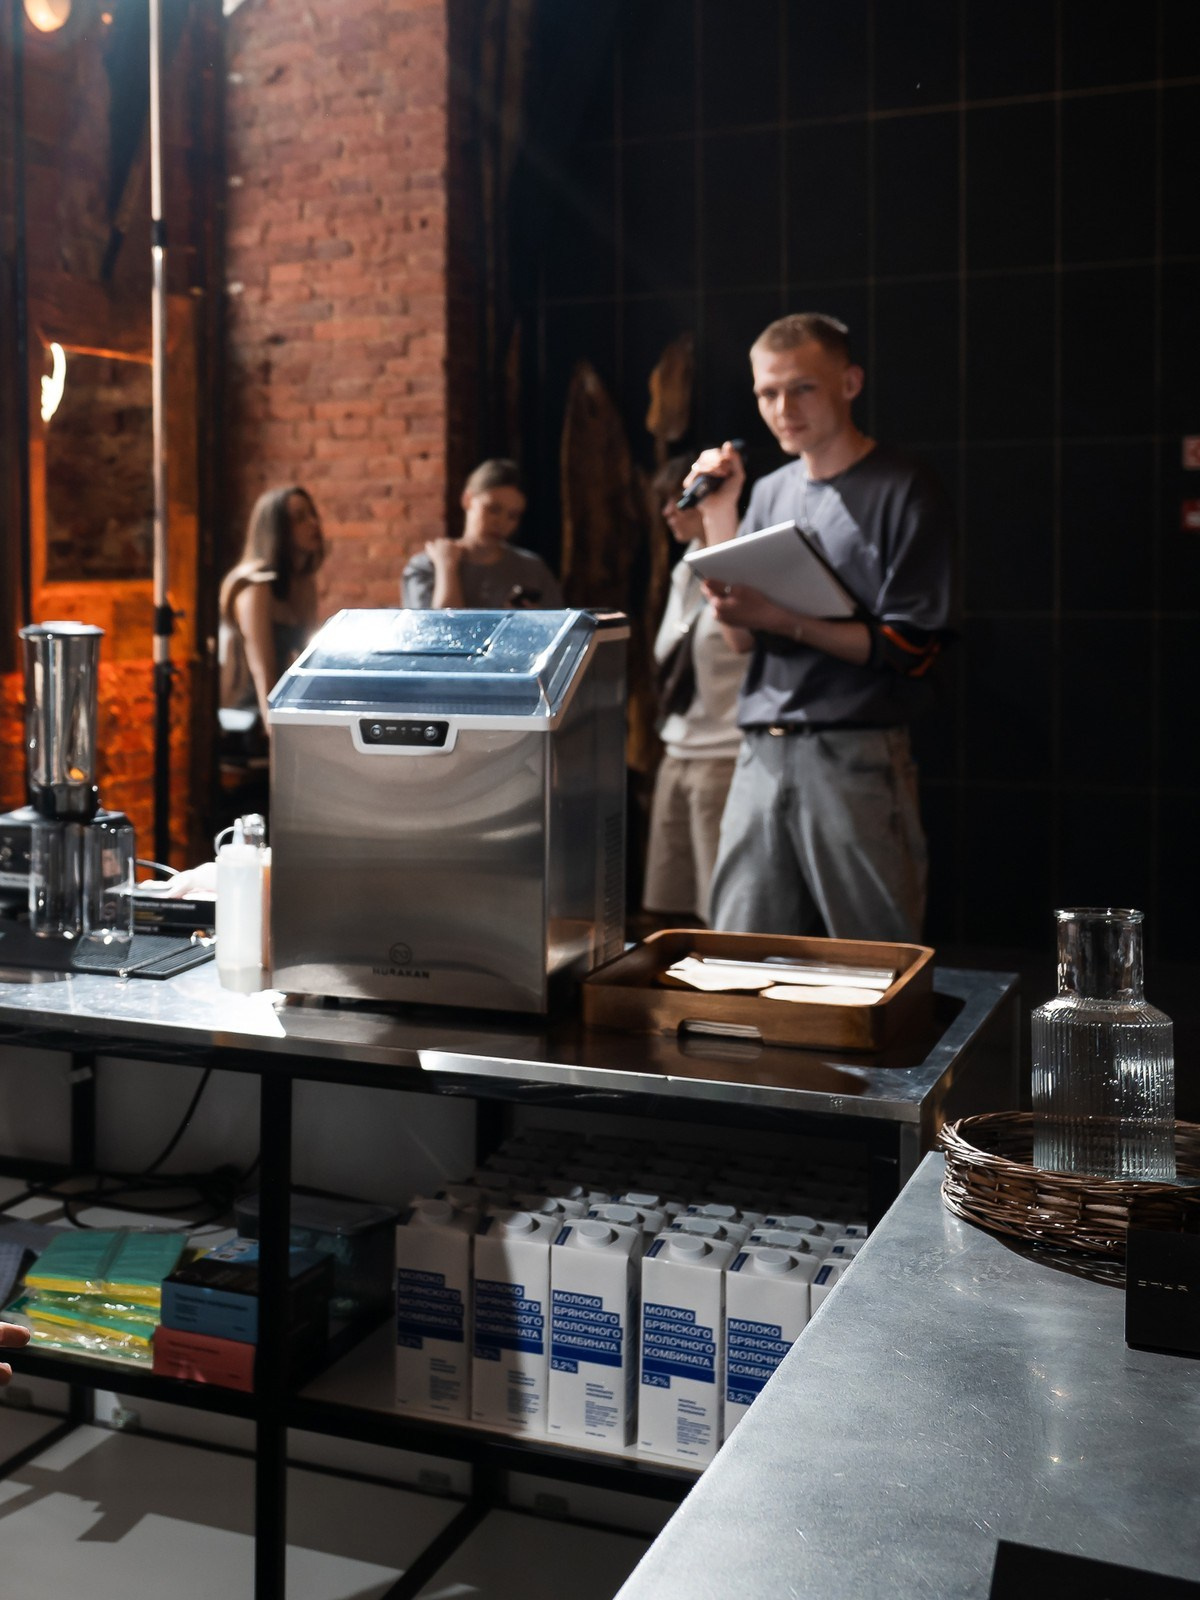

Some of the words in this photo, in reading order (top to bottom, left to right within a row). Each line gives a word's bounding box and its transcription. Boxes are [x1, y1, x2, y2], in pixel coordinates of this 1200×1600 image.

[553, 1292, 601, 1307] МОЛОКО
[553, 1306, 619, 1325] БРЯНСКОГО
[645, 1305, 694, 1321] МОЛОКО
[553, 1319, 621, 1339] МОЛОЧНОГО
[644, 1319, 712, 1339] БРЯНСКОГО
[729, 1320, 780, 1337] МОЛОКО
[552, 1333, 618, 1352] КОМБИНАТА
[644, 1333, 714, 1354] МОЛОЧНОГО
[729, 1335, 790, 1353] БРЯНСКОГ
[644, 1347, 711, 1367] КОМБИНАТА
[729, 1349, 783, 1365] МОЛОЧН
[729, 1363, 773, 1378] КОМБИ
